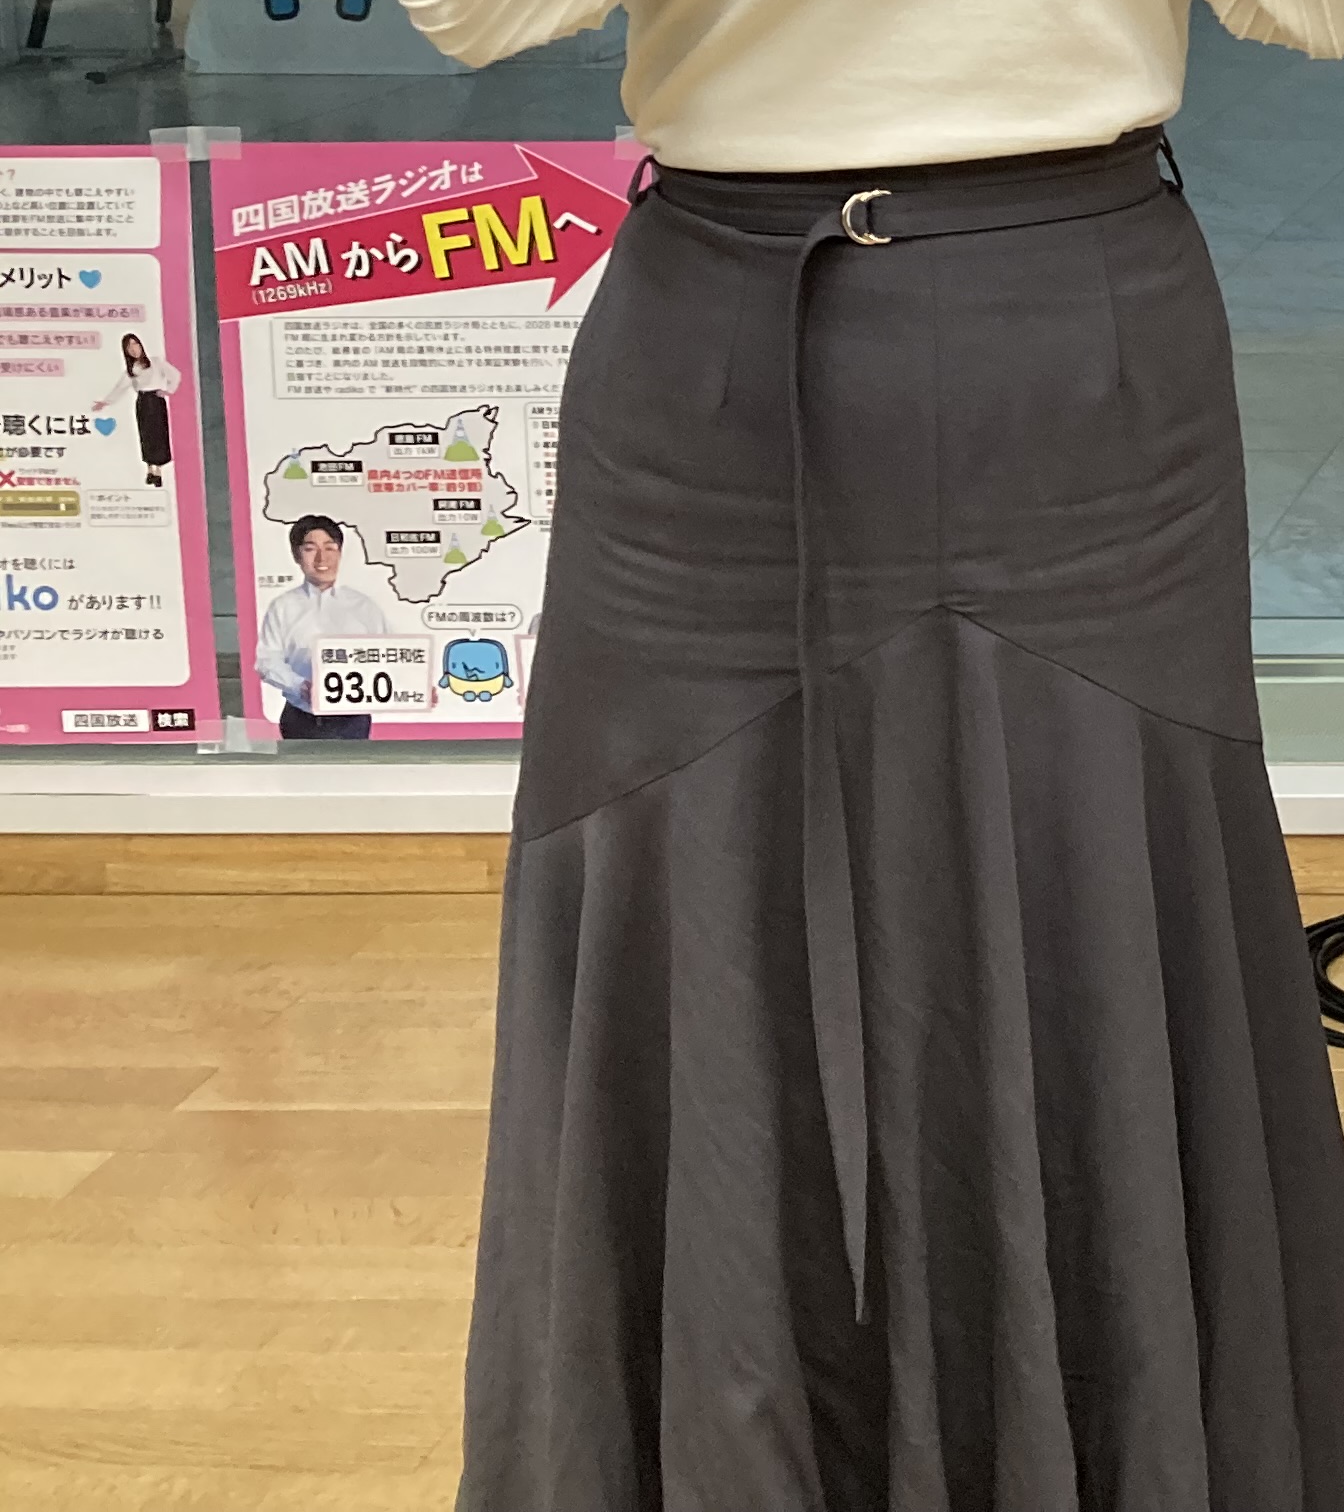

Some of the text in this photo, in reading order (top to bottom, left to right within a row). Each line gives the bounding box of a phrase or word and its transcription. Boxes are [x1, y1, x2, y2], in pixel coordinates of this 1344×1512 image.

[231, 159, 485, 238] 四国放送ラジオは
[251, 278, 334, 306] (1269kHz)
[0, 414, 91, 436] 聴くには
[0, 573, 59, 611] ko
[323, 671, 425, 704] 93.0 MHz
